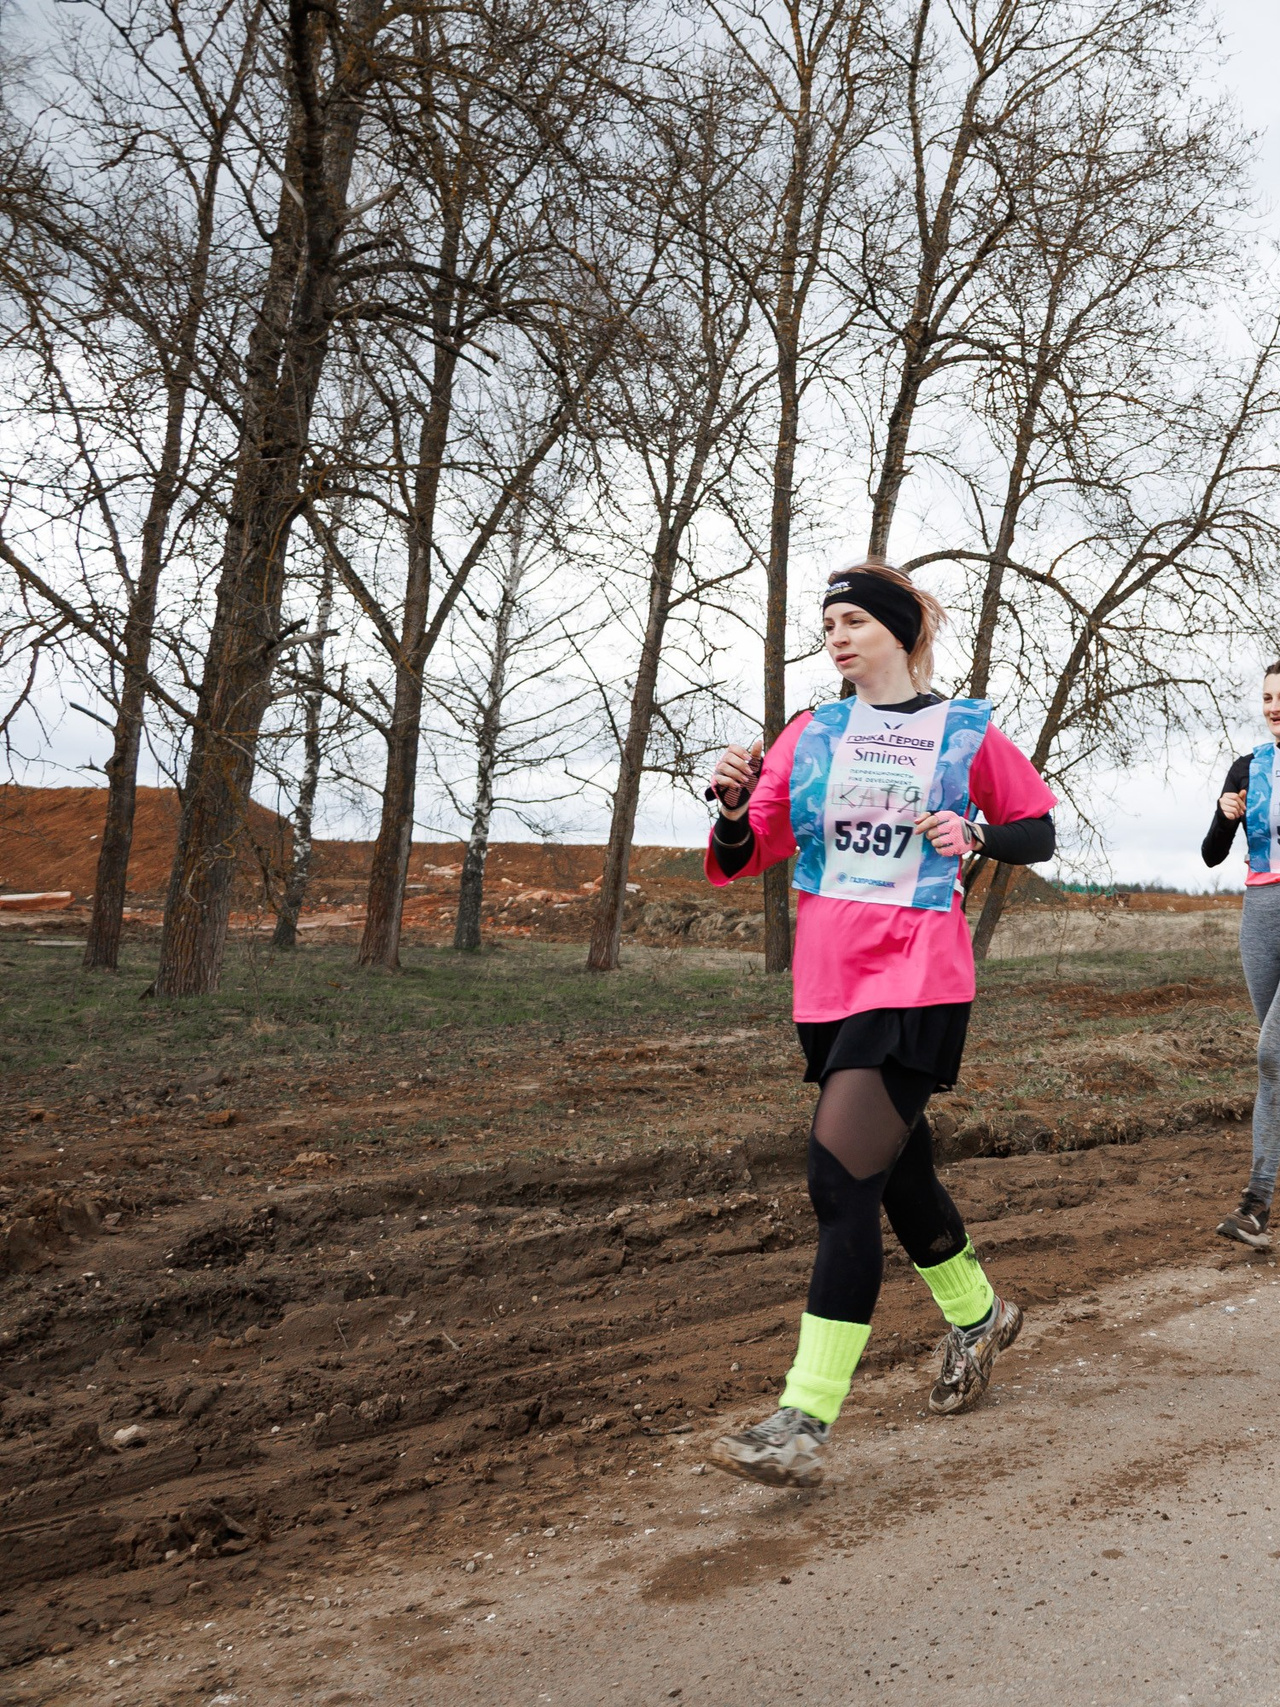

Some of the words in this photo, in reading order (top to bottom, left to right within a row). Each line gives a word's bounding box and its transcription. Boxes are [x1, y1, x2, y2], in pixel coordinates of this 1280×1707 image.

[847, 734, 885, 742] ГОНКА
[889, 734, 935, 748] ГЕРОЕВ
[853, 747, 918, 767] Sminex
[835, 820, 914, 859] 5397
